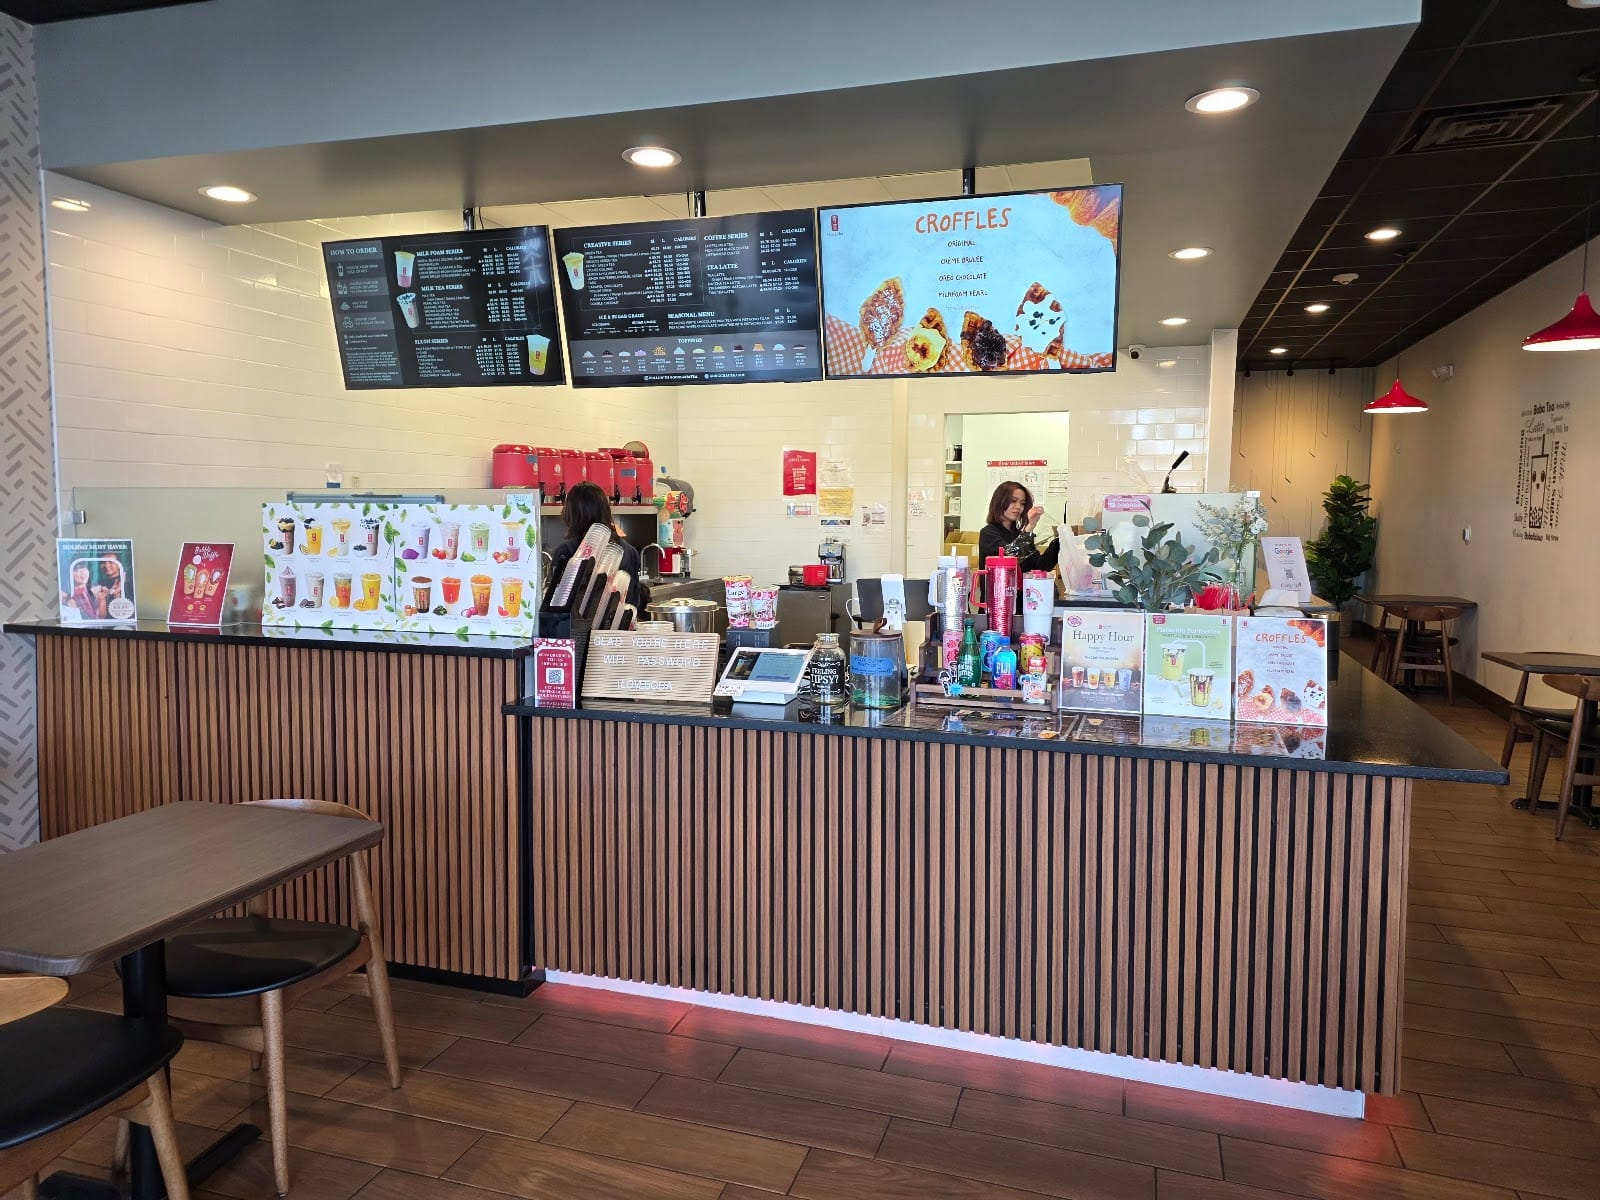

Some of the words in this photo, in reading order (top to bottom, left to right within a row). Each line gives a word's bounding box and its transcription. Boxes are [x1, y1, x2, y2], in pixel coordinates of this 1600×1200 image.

[915, 207, 1012, 234] CROFFLES
[356, 246, 378, 254] ORDER
[1533, 404, 1546, 416] Boba
[1546, 402, 1555, 412] Tea
[1525, 416, 1546, 434] Latte
[1552, 440, 1560, 484] Brown
[1274, 547, 1294, 555] Google
[727, 589, 745, 597] Large
[1072, 630, 1105, 644] Happy
[1108, 631, 1136, 642] Hour
[1255, 633, 1307, 644] CROFFLES
[594, 637, 623, 647] GLAD
[674, 639, 709, 649] HERE
[603, 655, 625, 665] WIFI
[811, 667, 837, 675] FEELING
[996, 661, 1012, 674] FIJI
[811, 674, 839, 684] TIPSY?
